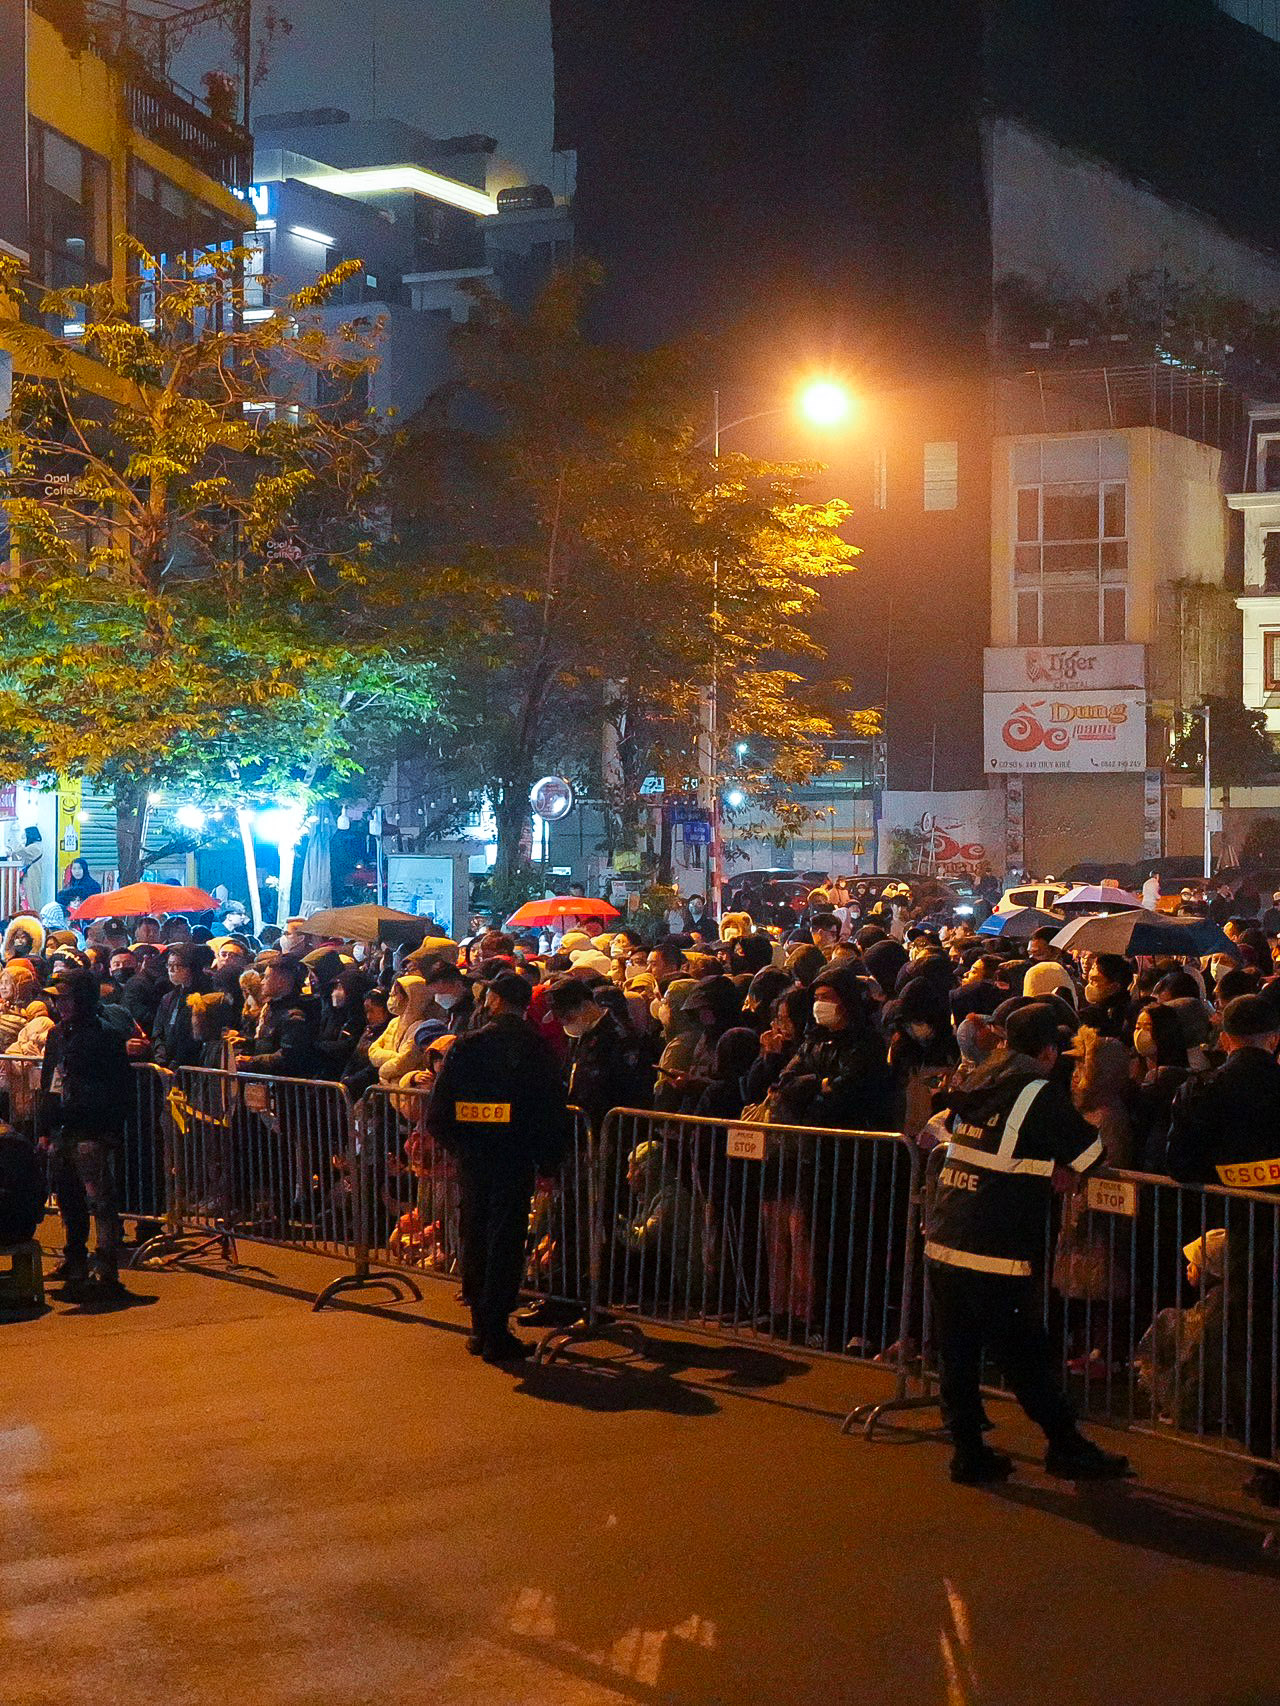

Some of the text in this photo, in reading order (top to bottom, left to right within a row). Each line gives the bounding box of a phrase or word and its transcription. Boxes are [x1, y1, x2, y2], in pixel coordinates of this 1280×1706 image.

[44, 473, 70, 484] Opal
[1048, 651, 1097, 679] Tiger
[1049, 702, 1128, 724] Dung
[734, 1142, 757, 1153] STOP
[1096, 1192, 1125, 1209] STOP
